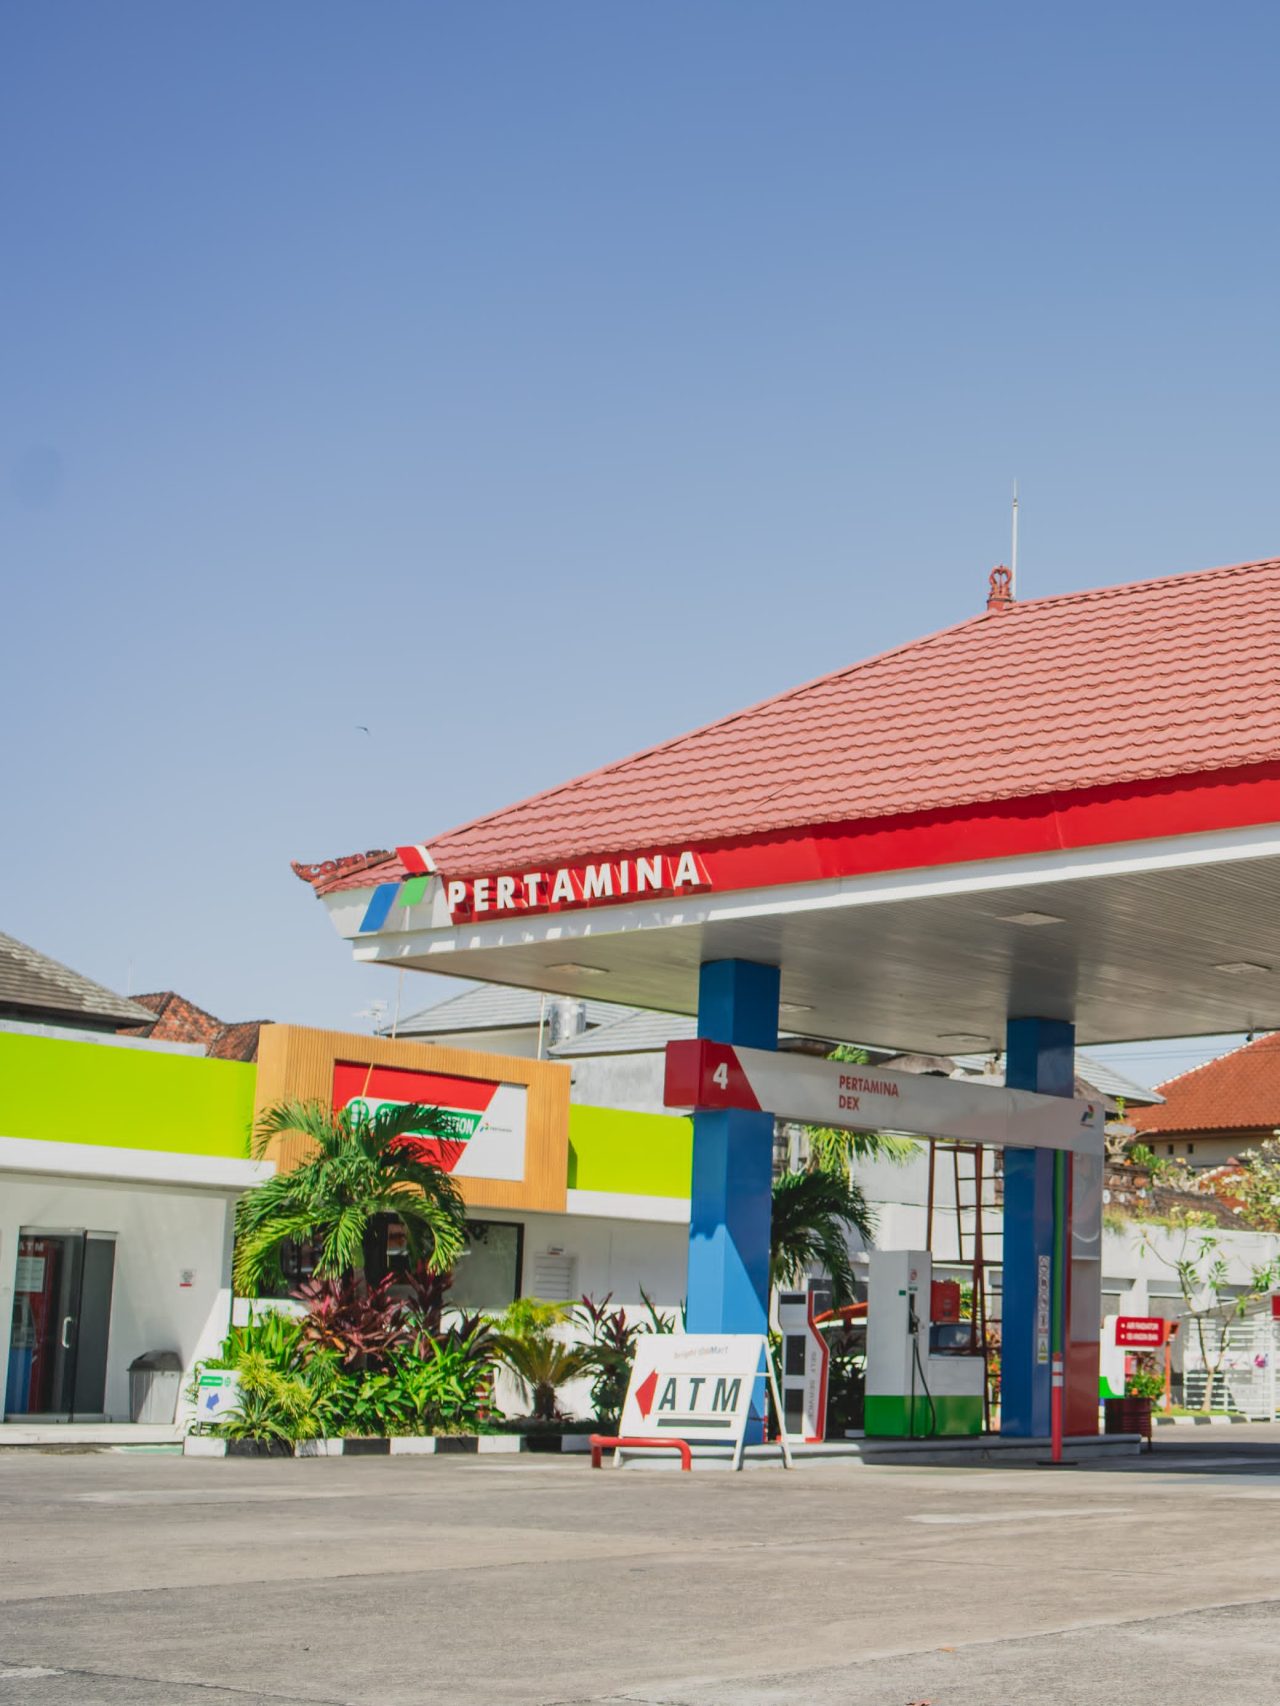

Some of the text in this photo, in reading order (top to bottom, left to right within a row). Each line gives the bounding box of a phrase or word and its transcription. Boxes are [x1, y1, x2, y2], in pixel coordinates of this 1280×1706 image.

[447, 851, 702, 914] PERTAMINA
[712, 1062, 728, 1090] 4
[839, 1075, 899, 1097] PERTAMINA
[838, 1094, 860, 1112] DEX
[657, 1377, 742, 1412] ATM
